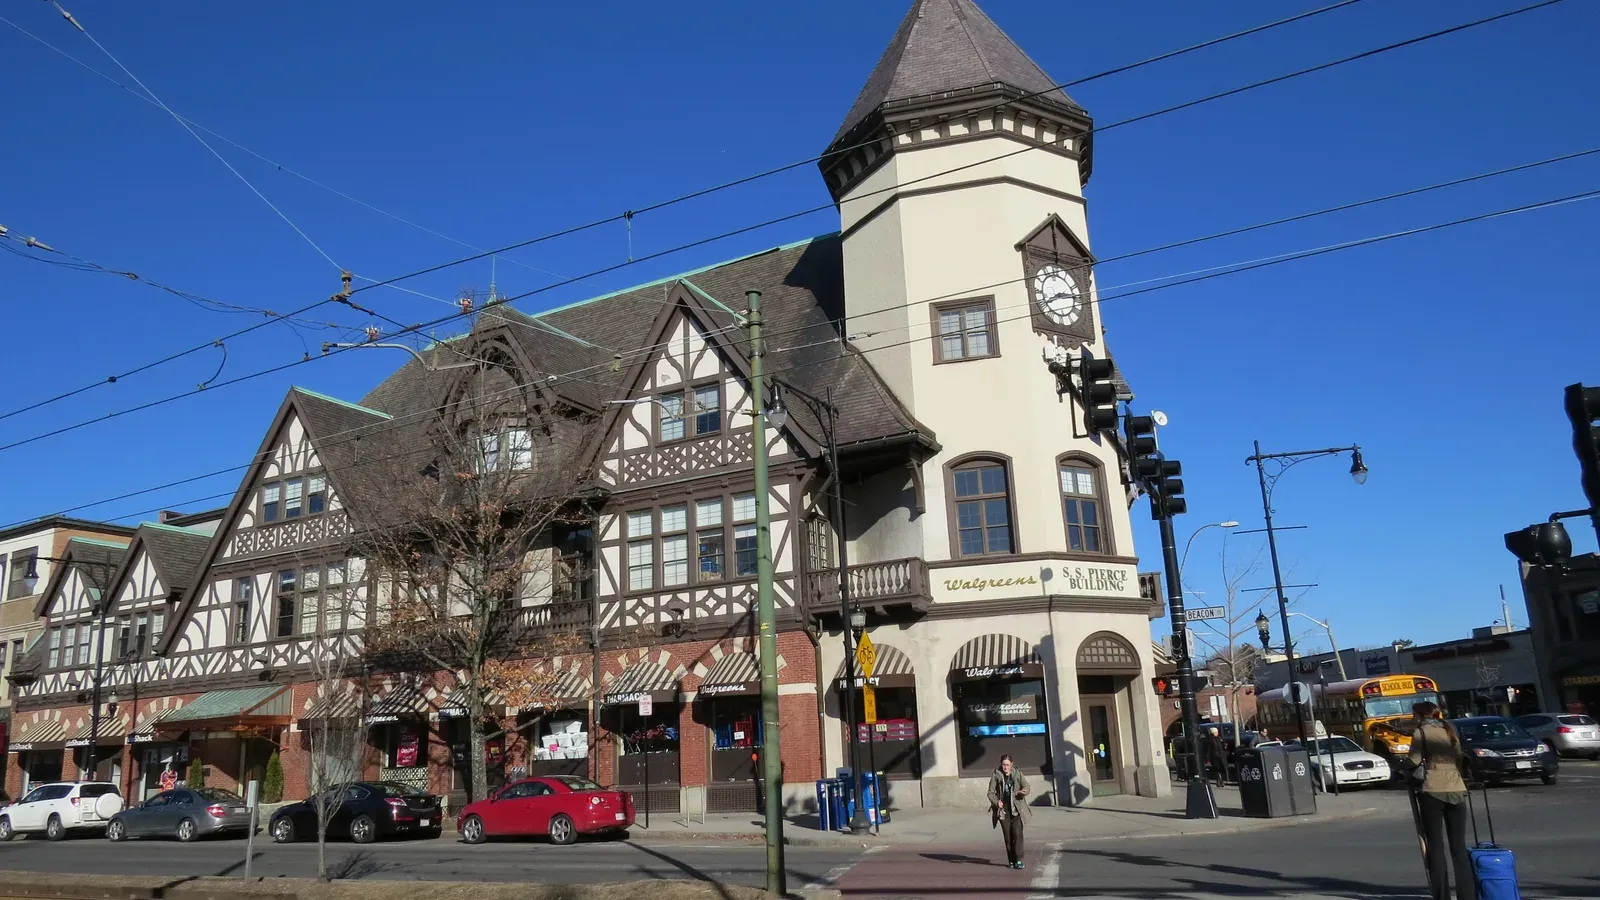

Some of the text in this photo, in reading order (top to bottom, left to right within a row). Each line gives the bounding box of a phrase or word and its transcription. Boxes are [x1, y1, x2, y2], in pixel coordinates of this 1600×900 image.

[1088, 568, 1128, 581] PIERCE
[943, 575, 1038, 592] Walgreens
[1069, 577, 1124, 592] BUILDING
[1188, 609, 1215, 620] BEACON
[965, 667, 1025, 679] Walgreens
[840, 677, 880, 689] PHMCY
[1381, 681, 1414, 691] SCHOOL BUS
[607, 691, 648, 703] PHARMAC
